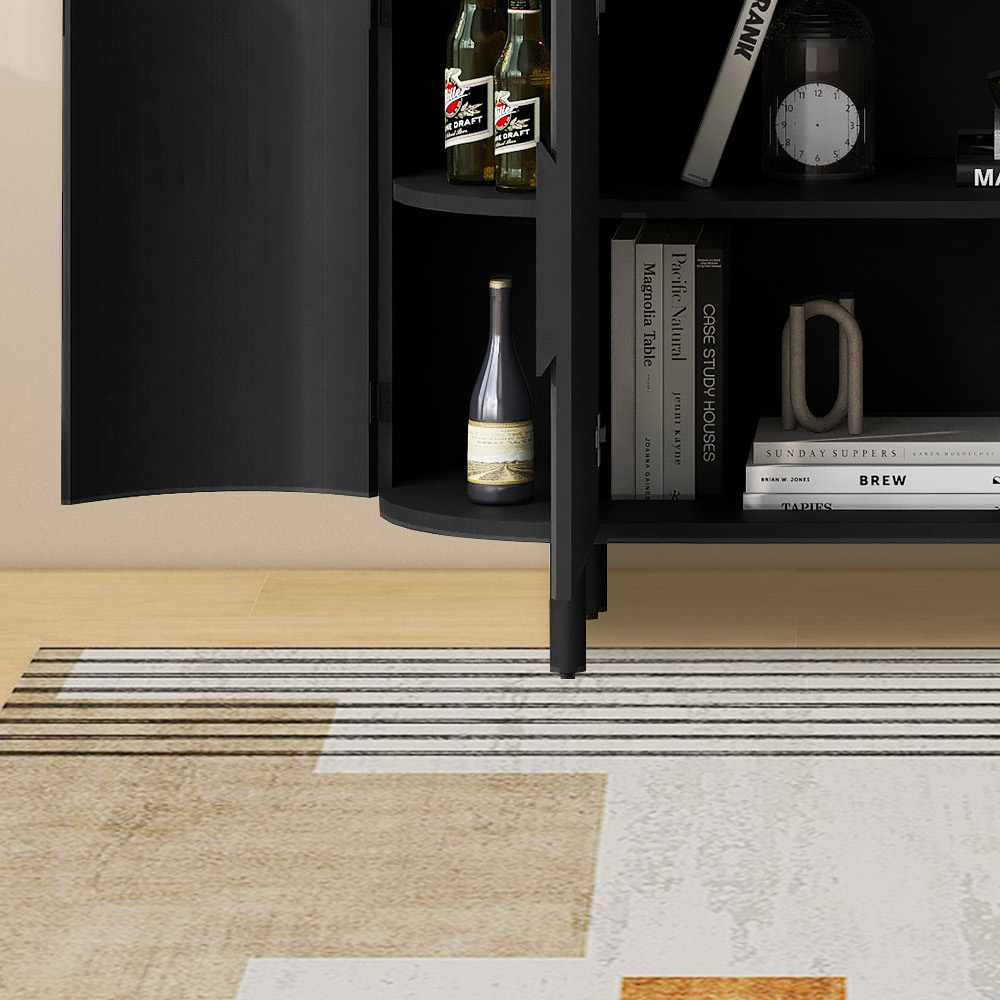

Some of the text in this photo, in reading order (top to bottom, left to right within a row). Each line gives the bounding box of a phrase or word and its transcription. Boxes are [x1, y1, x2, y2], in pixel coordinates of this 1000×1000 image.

[814, 89, 822, 97] 12
[453, 116, 483, 129] DRAFT
[503, 128, 530, 139] DRAFT
[671, 253, 687, 361] Pacific Natural
[640, 263, 656, 367] Magnolia Table
[703, 303, 716, 462] CASE STUDY HOUSES
[766, 449, 897, 458] SUNDAY SUPPERS
[859, 475, 907, 486] BREW
